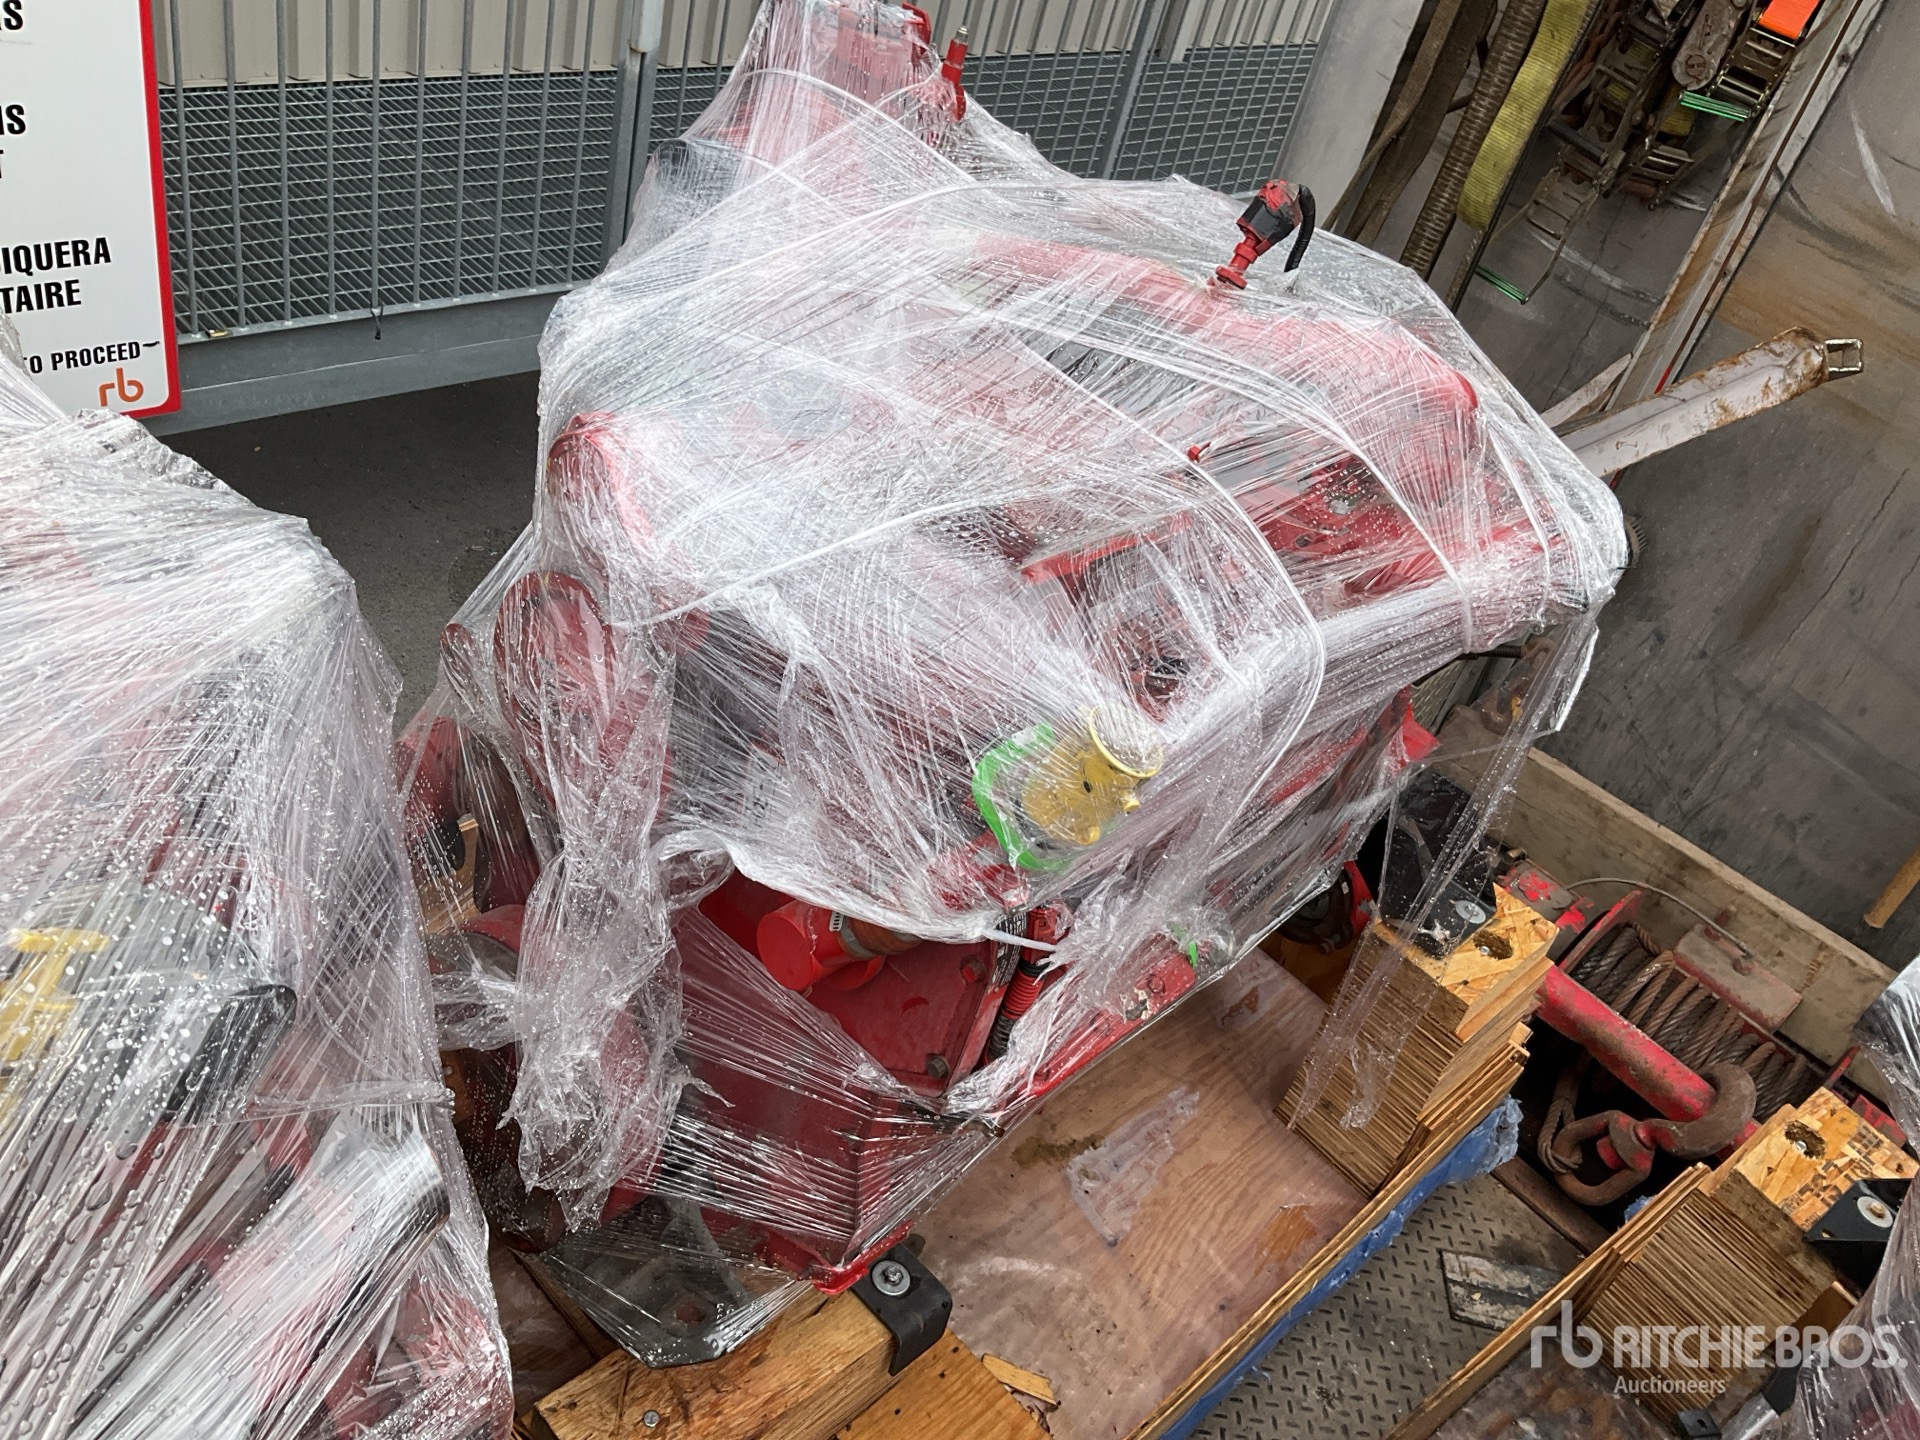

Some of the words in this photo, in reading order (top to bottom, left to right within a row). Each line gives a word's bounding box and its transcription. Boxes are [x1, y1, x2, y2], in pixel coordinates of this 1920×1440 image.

[0, 279, 81, 314] TAIRE
[23, 355, 43, 374] O
[51, 341, 141, 371] PROCEED
[98, 367, 144, 407] rb
